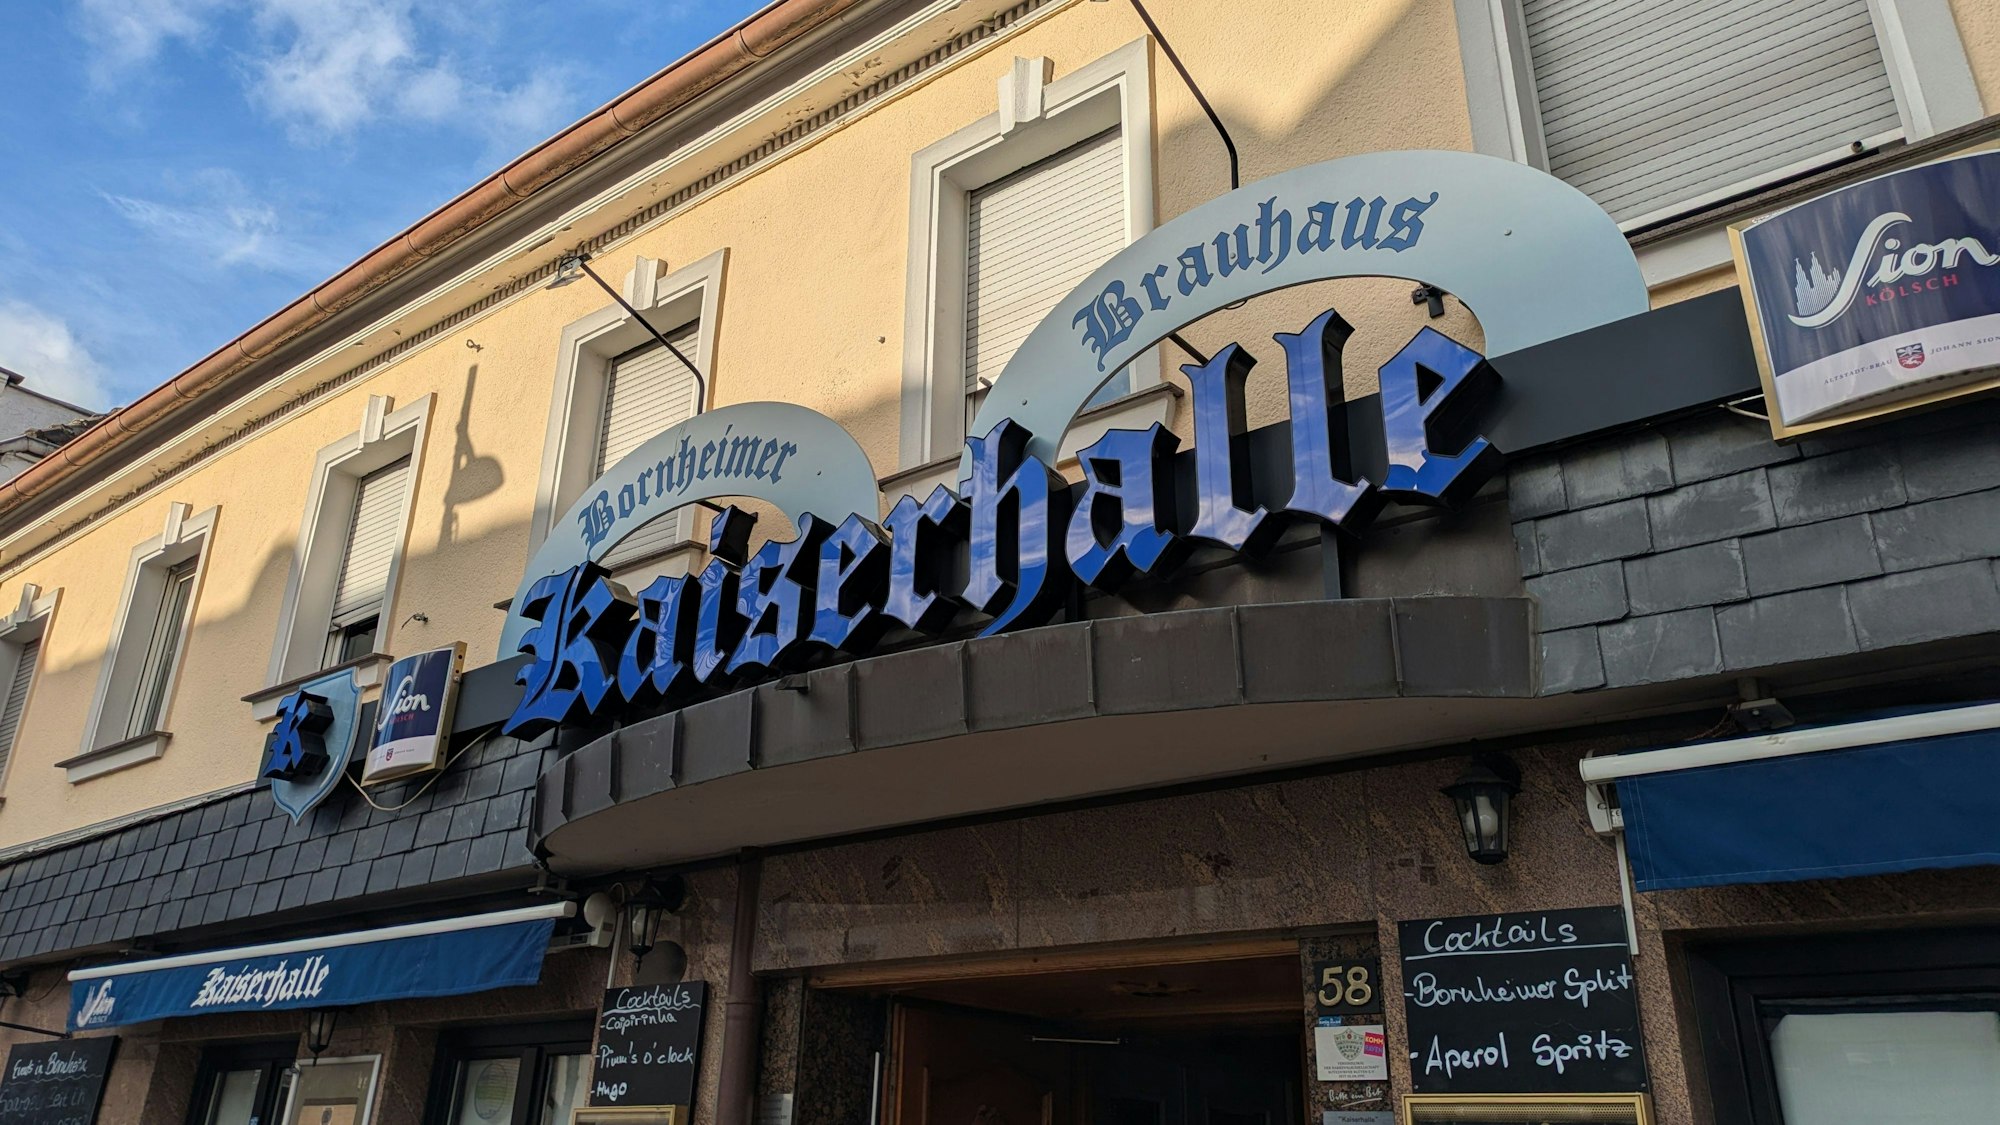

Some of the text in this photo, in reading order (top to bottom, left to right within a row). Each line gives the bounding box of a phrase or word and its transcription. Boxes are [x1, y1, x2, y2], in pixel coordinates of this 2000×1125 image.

[1072, 191, 1439, 371] Brauhaus
[1788, 211, 2000, 329] Sion
[1866, 274, 1958, 306] KÖLSCH
[1930, 341, 1973, 355] JOHANN
[577, 424, 797, 561] Bornheimer
[502, 307, 1490, 737] Kaiserhalle
[378, 674, 431, 731] Sion
[1424, 917, 1578, 953] Cocktails
[190, 955, 330, 1008] Kaiserhalle
[616, 985, 690, 1010] Cocktails
[1318, 965, 1372, 1007] 58
[1563, 963, 1633, 1008] Split
[1532, 1030, 1633, 1074] Spritz
